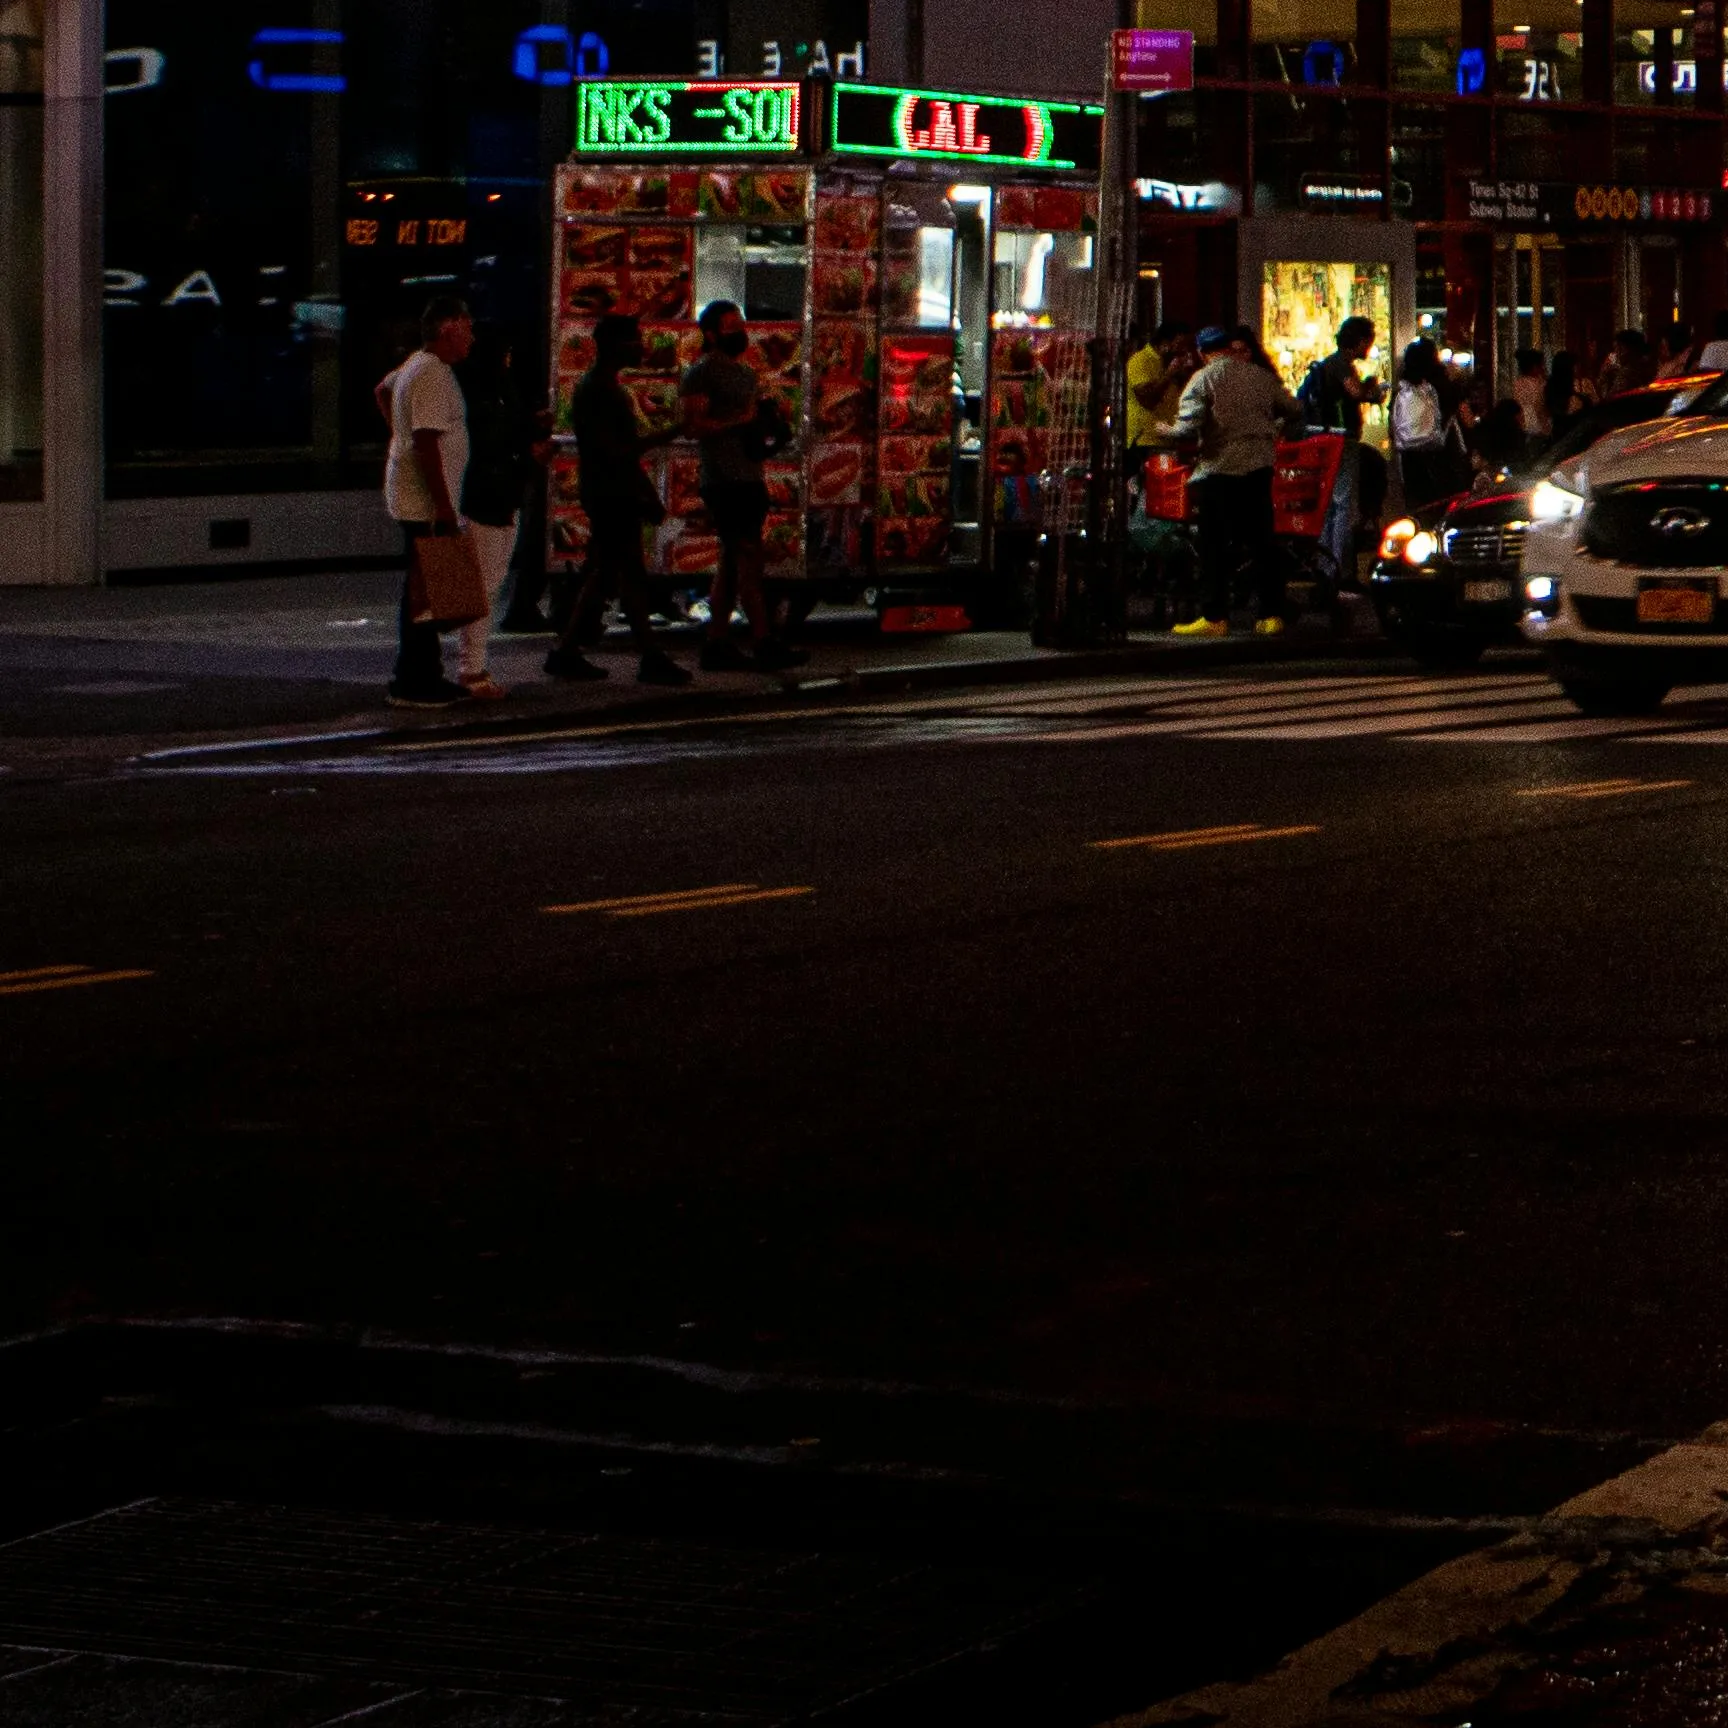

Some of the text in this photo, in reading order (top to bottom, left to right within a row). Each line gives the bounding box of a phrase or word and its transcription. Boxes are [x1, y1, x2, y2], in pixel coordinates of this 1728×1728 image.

[1118, 37, 1180, 50] NO STANDING
[586, 88, 671, 143] NKS
[1469, 181, 1496, 198] Times
[1469, 201, 1503, 219] Subway
